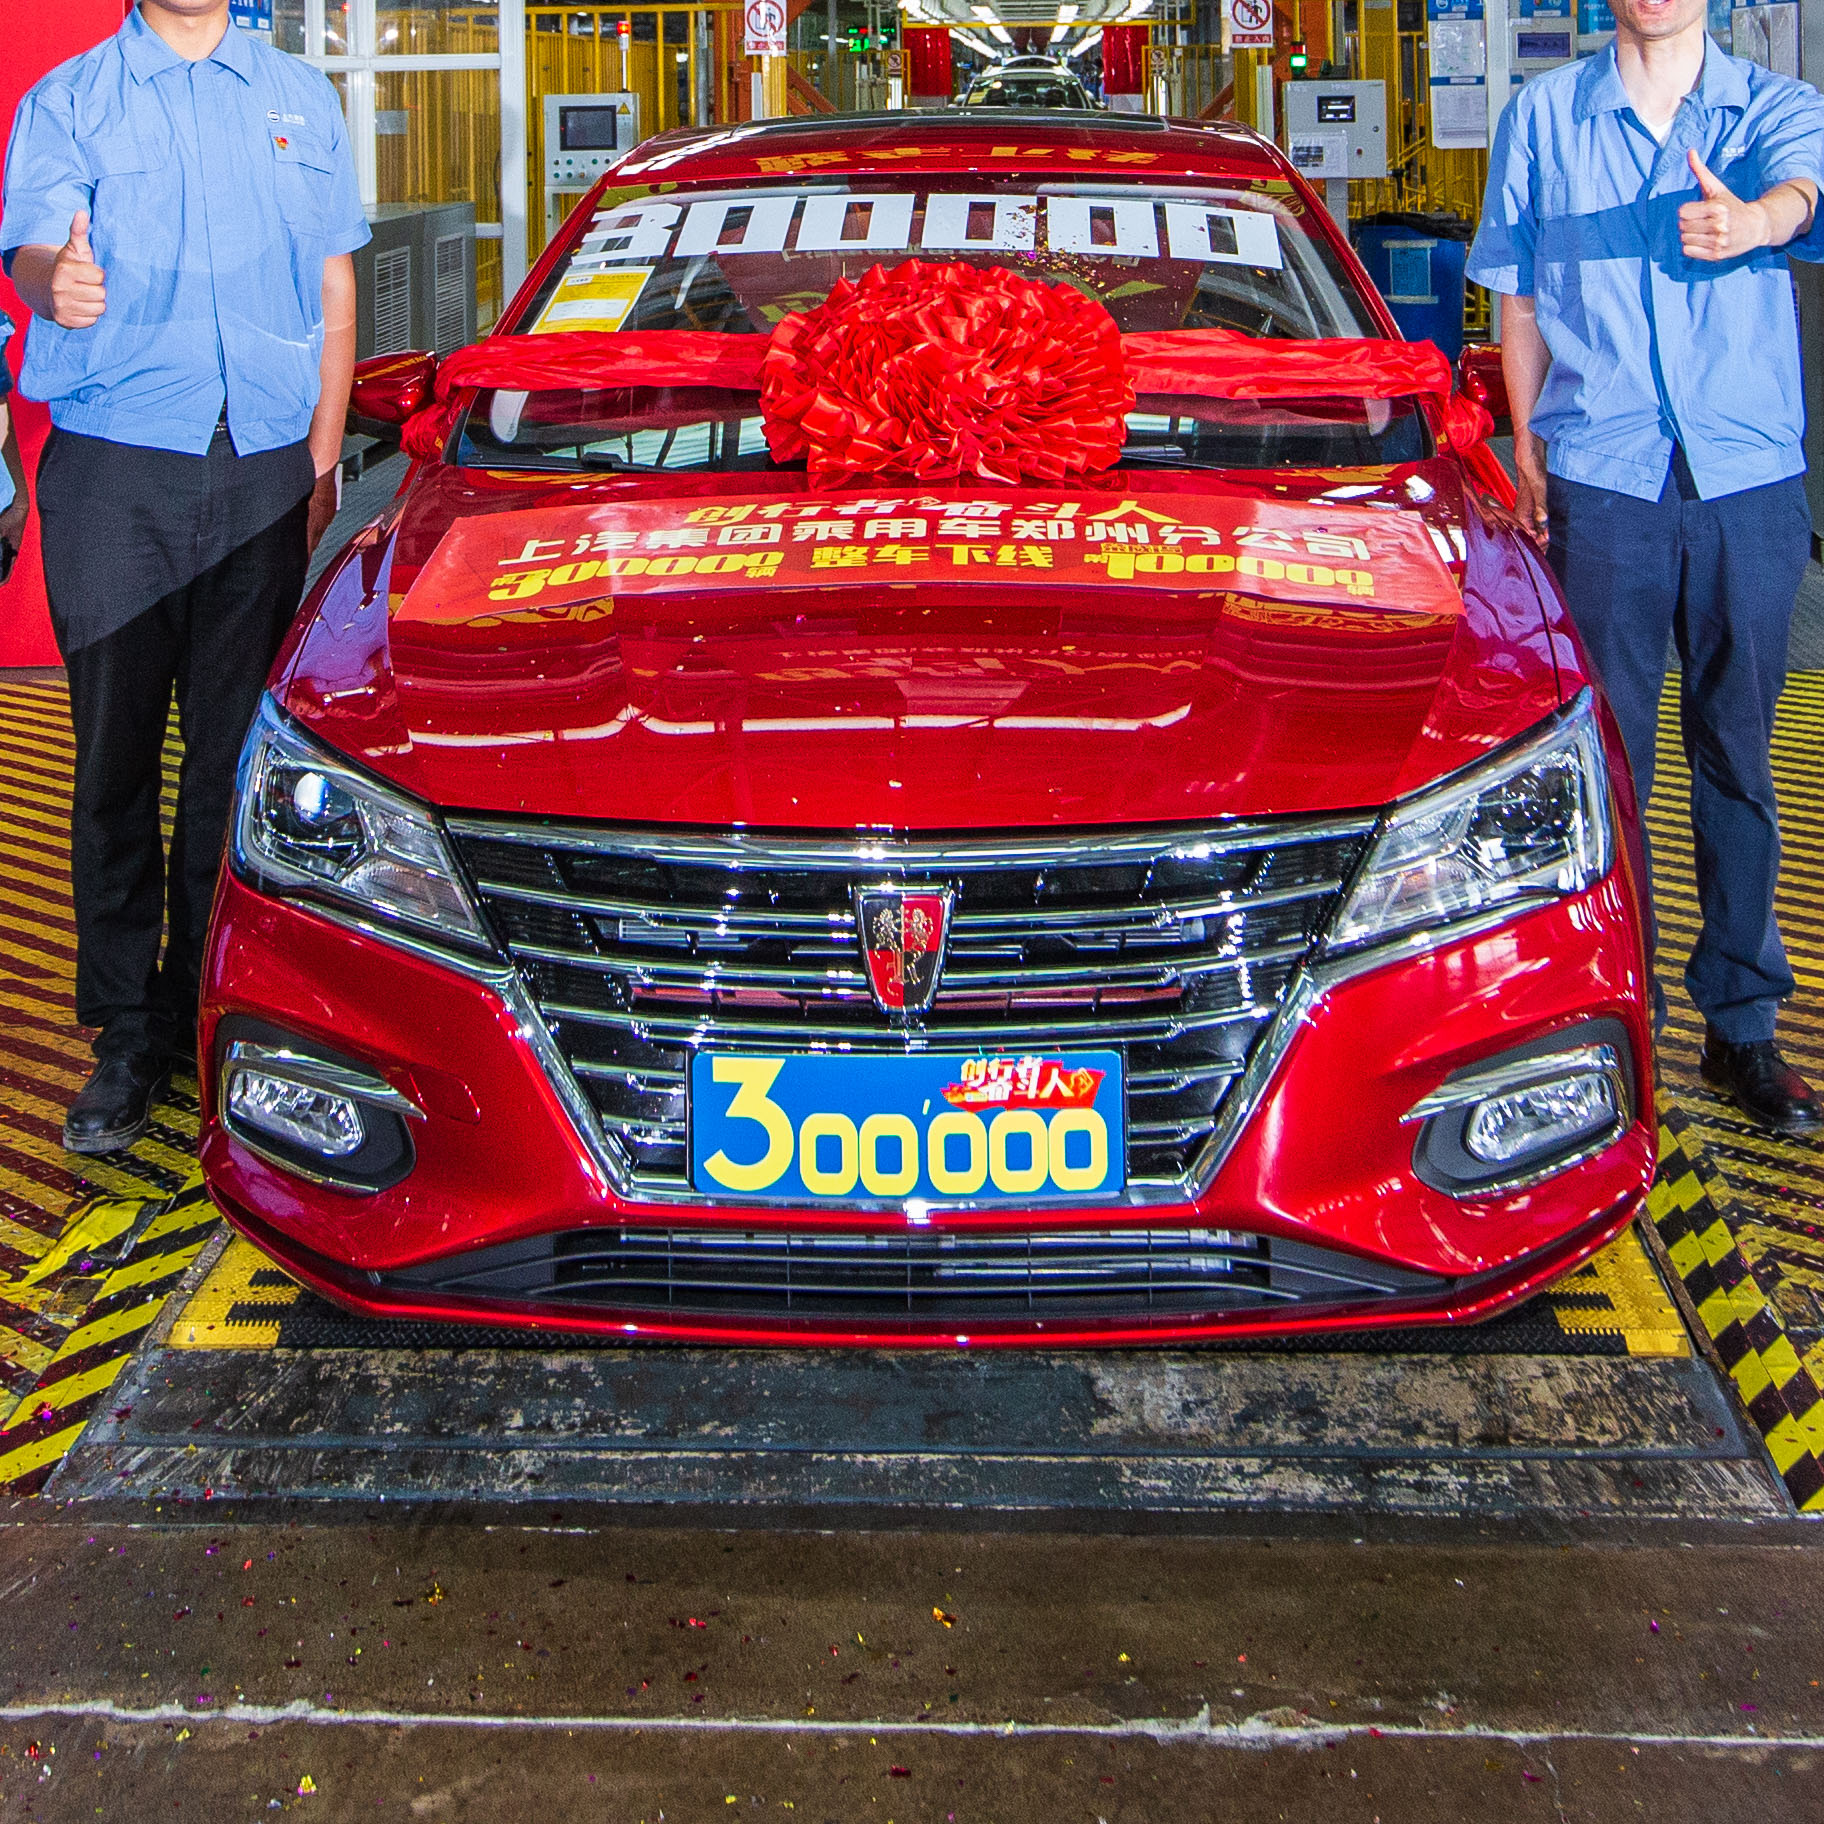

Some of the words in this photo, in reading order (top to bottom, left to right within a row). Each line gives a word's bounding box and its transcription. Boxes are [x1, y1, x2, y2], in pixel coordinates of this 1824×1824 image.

[572, 193, 1283, 268] 300000
[498, 518, 1371, 565] 上汽集团乘用车郑州分公司
[811, 544, 1053, 569] 整车下线
